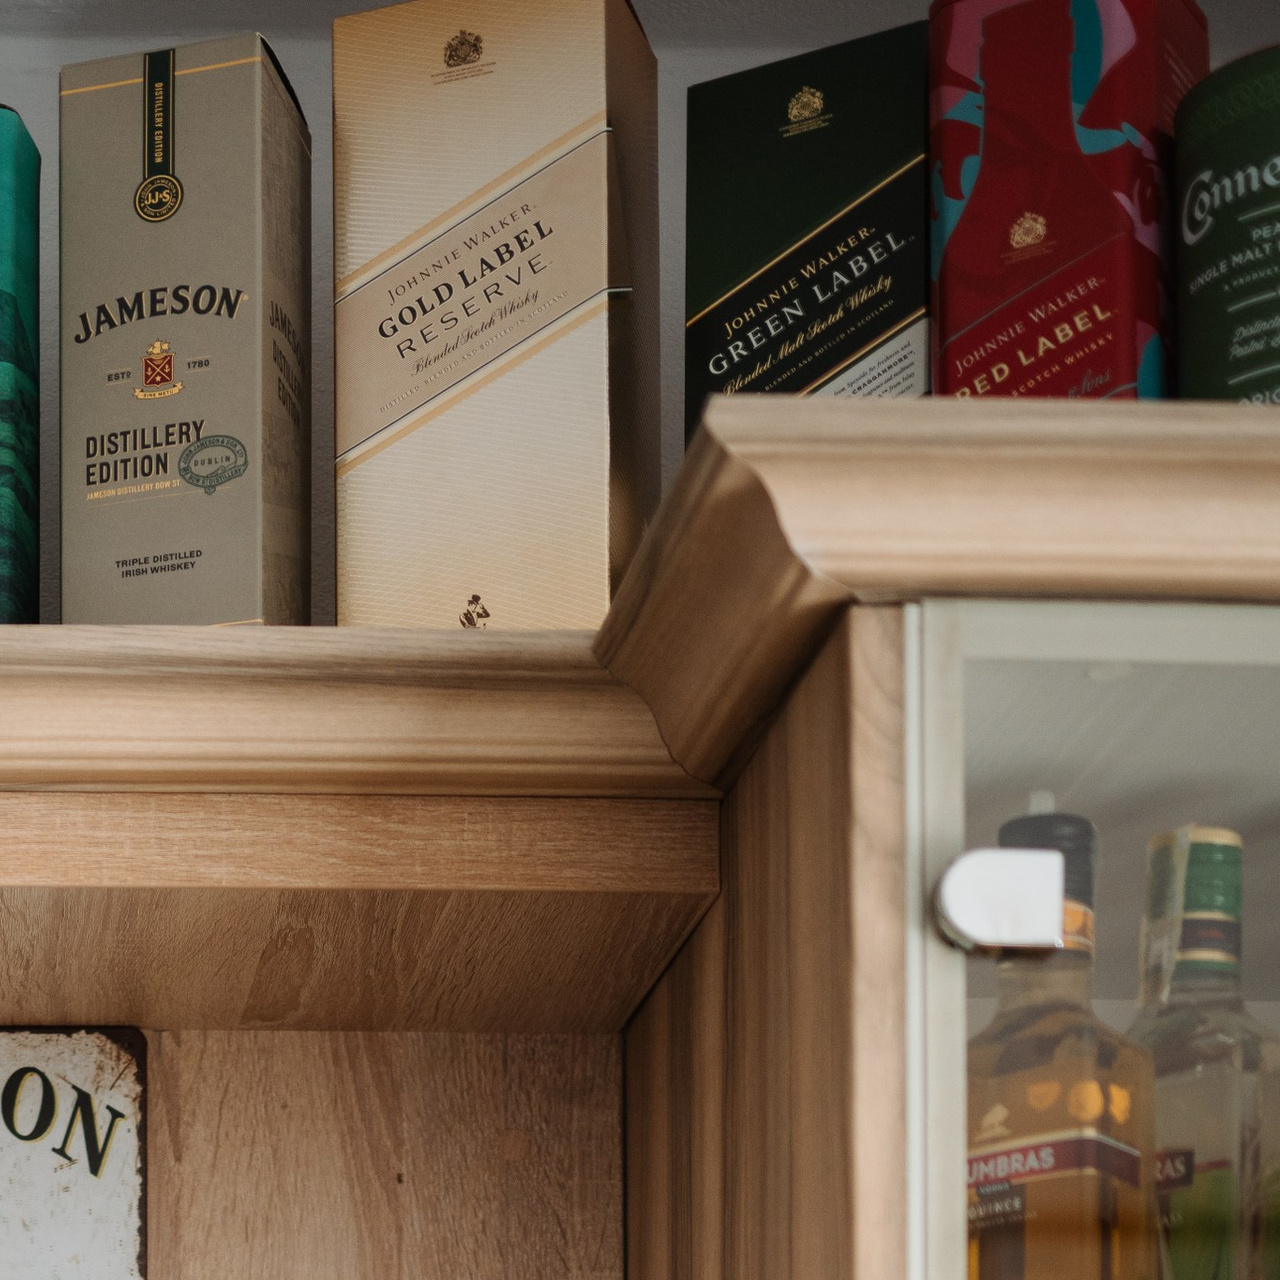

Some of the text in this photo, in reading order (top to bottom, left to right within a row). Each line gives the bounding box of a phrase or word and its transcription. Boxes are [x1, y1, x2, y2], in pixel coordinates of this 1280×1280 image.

[378, 220, 554, 339] GOLD LABEL
[387, 203, 533, 306] JOHNNIE WALKER
[724, 227, 870, 339] JOHNNIE WALKER
[1189, 242, 1273, 295] SINGLE MALT
[74, 285, 244, 344] JAMESON
[396, 253, 548, 359] RESERVE
[709, 232, 906, 375] GREEN LABEL
[723, 275, 892, 397] Blended Malt Scotch Whisky
[956, 277, 1100, 377] JOHNNIE WALKER
[187, 360, 210, 369] 1780
[955, 304, 1112, 400] RED LABEL
[1012, 333, 1114, 398] SCOTCH WHISKY
[86, 419, 205, 458] DISTILLERY
[86, 452, 169, 486] EDITION
[115, 550, 202, 568] TRIPLE DISTILLED
[122, 561, 196, 578] IRISH WHISKEY
